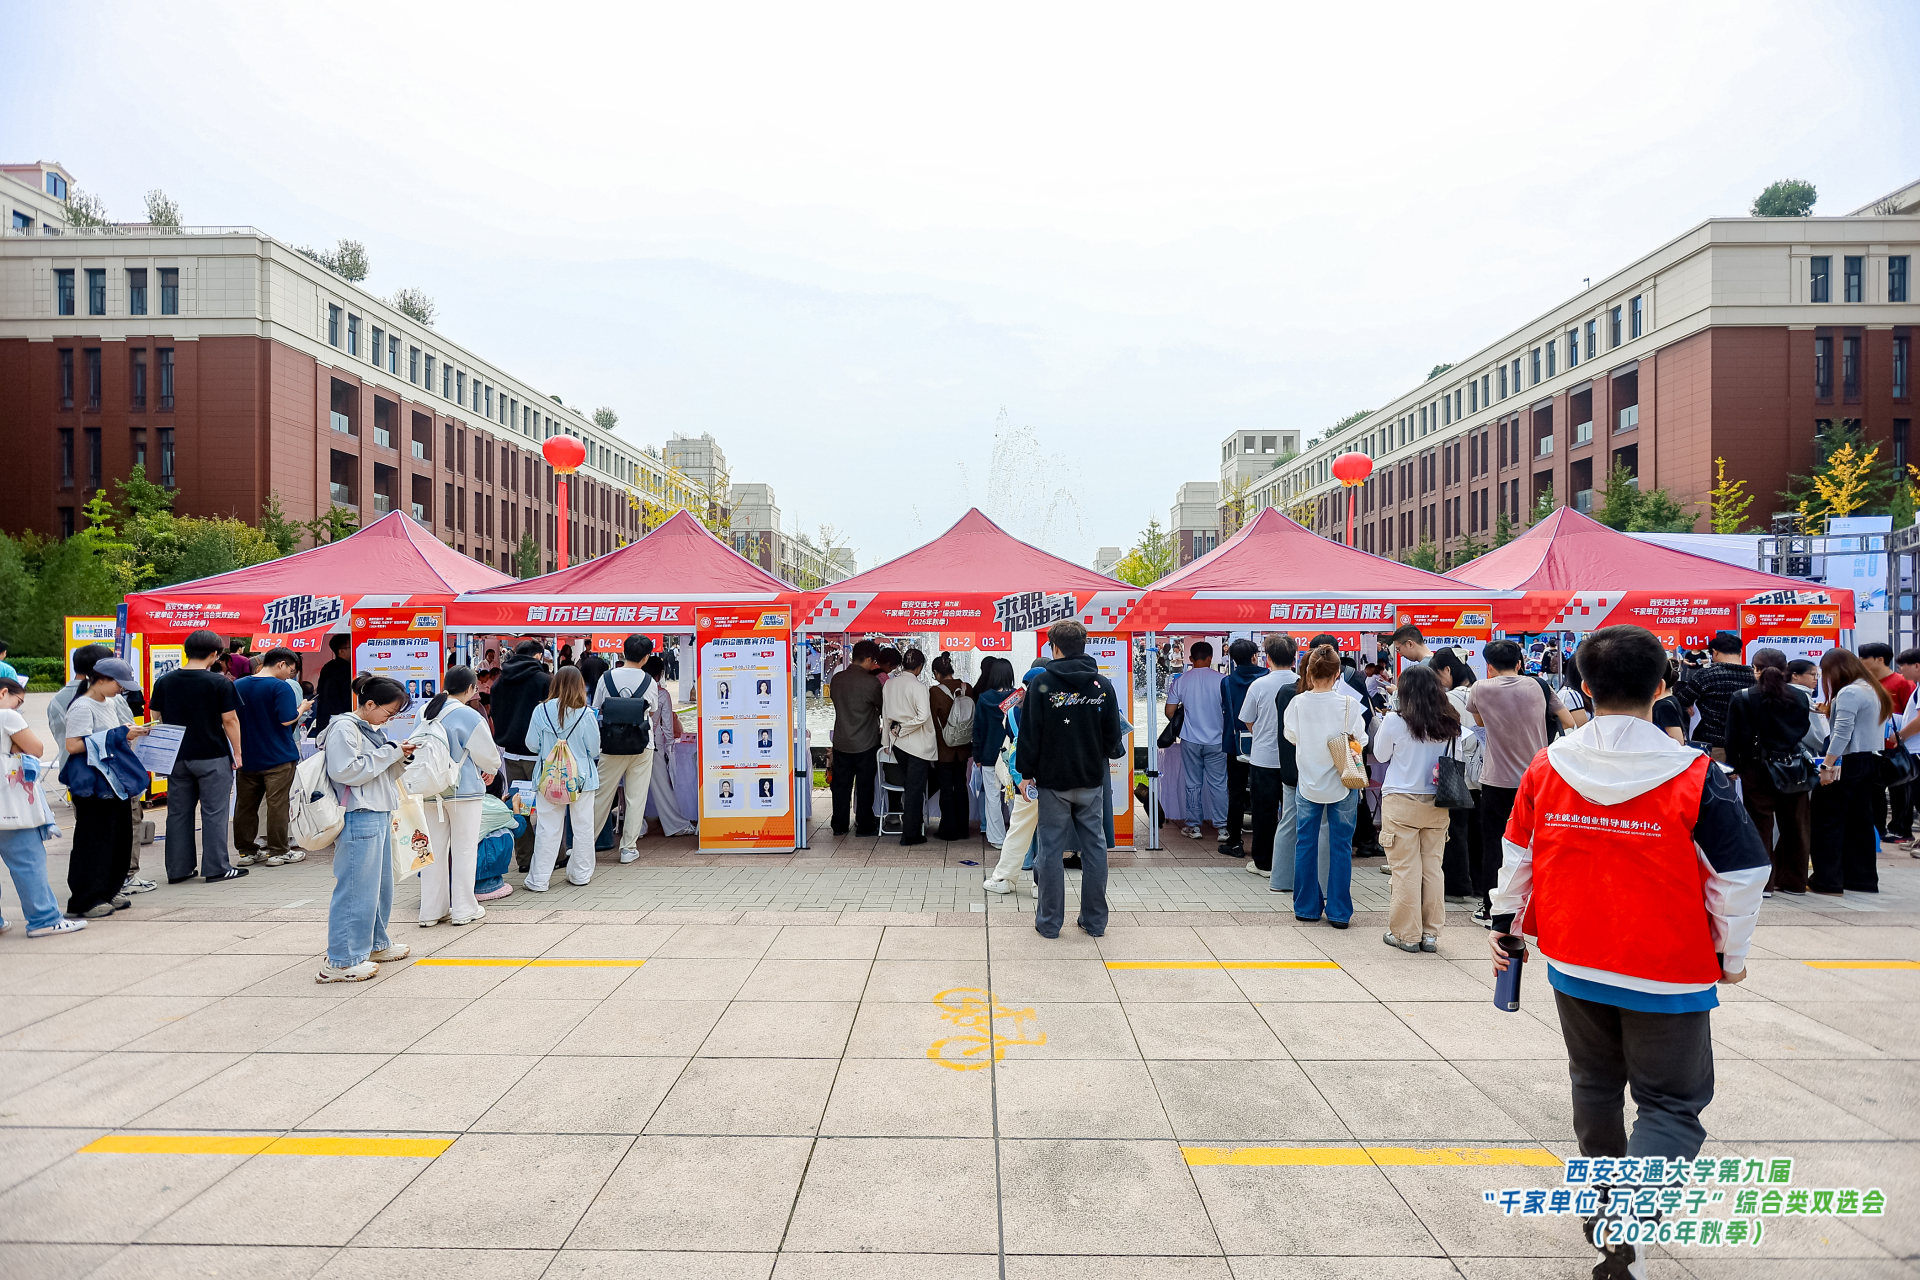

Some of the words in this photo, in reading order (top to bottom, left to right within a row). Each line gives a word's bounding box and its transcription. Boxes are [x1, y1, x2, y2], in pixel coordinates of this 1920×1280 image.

[901, 600, 940, 609] 西安交通大学
[997, 591, 1043, 620] 求职
[1649, 599, 1689, 607] 西安交通大学
[526, 605, 681, 622] 简历诊断服务区
[1268, 603, 1395, 620] 简历诊断服务
[258, 638, 283, 648] 05-2
[292, 638, 316, 648] 05-1
[598, 638, 622, 649] 04-2
[946, 637, 971, 647] 03-2
[981, 637, 1005, 647] 03-1
[1086, 636, 1116, 645] 嘉宾介绍
[1295, 637, 1311, 647] 02-
[1337, 637, 1354, 647] 2-1
[1657, 635, 1675, 646] 1-2
[1685, 635, 1709, 646] 01-1
[1544, 812, 1662, 832] 学生就业创业指导服务中心
